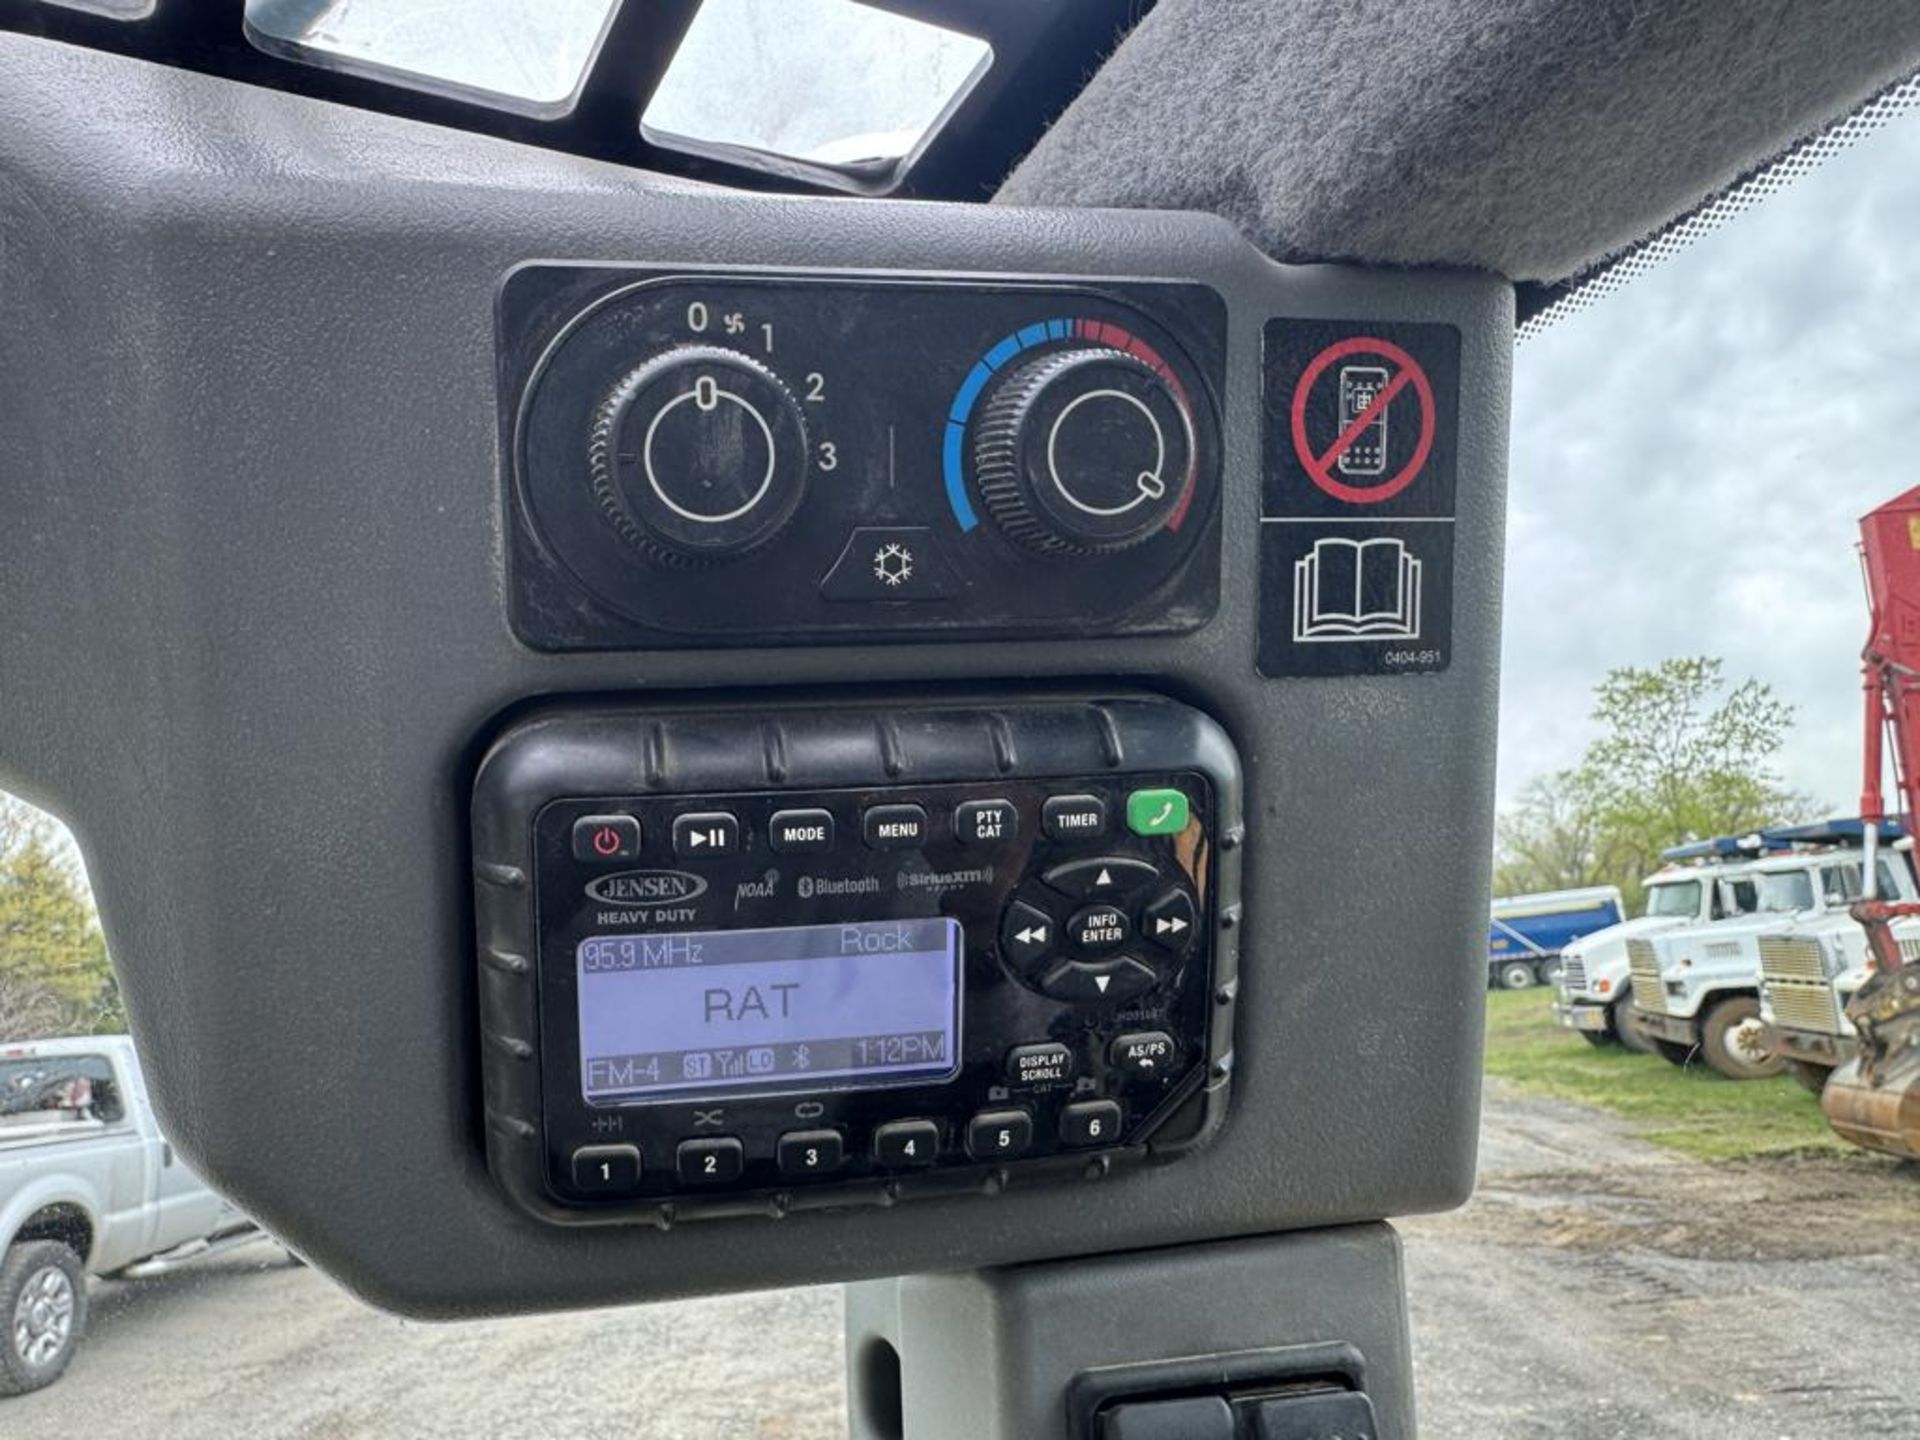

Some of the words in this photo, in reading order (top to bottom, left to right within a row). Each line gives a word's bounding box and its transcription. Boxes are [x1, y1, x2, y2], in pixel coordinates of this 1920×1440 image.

[688, 302, 708, 332] 0
[761, 324, 773, 352] 1
[806, 374, 826, 401] 2
[818, 443, 837, 471] 3
[1385, 649, 1440, 665] 0404-951
[976, 810, 1002, 824] PTY
[1057, 813, 1098, 828] TIMER
[784, 826, 825, 842] MODE
[878, 823, 918, 838] MENU
[976, 824, 1002, 838] CAT
[602, 874, 687, 898] JENSEN
[816, 877, 880, 895] Bluetooth
[598, 910, 648, 925] HEAVY
[655, 908, 697, 923] DUTY
[1088, 914, 1117, 927] INFO
[840, 927, 914, 954] Rock
[1081, 928, 1122, 943] ENTER
[584, 941, 636, 971] 95.9
[641, 935, 704, 967] MHz
[703, 982, 800, 1024] RAT
[1127, 1042, 1166, 1059] AS/PS
[1019, 1053, 1065, 1069] DISPLAY
[587, 1056, 661, 1088] FM-4
[1021, 1069, 1063, 1081] SCROLL
[1089, 1119, 1101, 1137] 6
[998, 1129, 1011, 1147] 5
[903, 1139, 916, 1156] 4
[704, 1156, 717, 1174] 2
[806, 1148, 818, 1166] 3
[600, 1162, 610, 1181] 1
